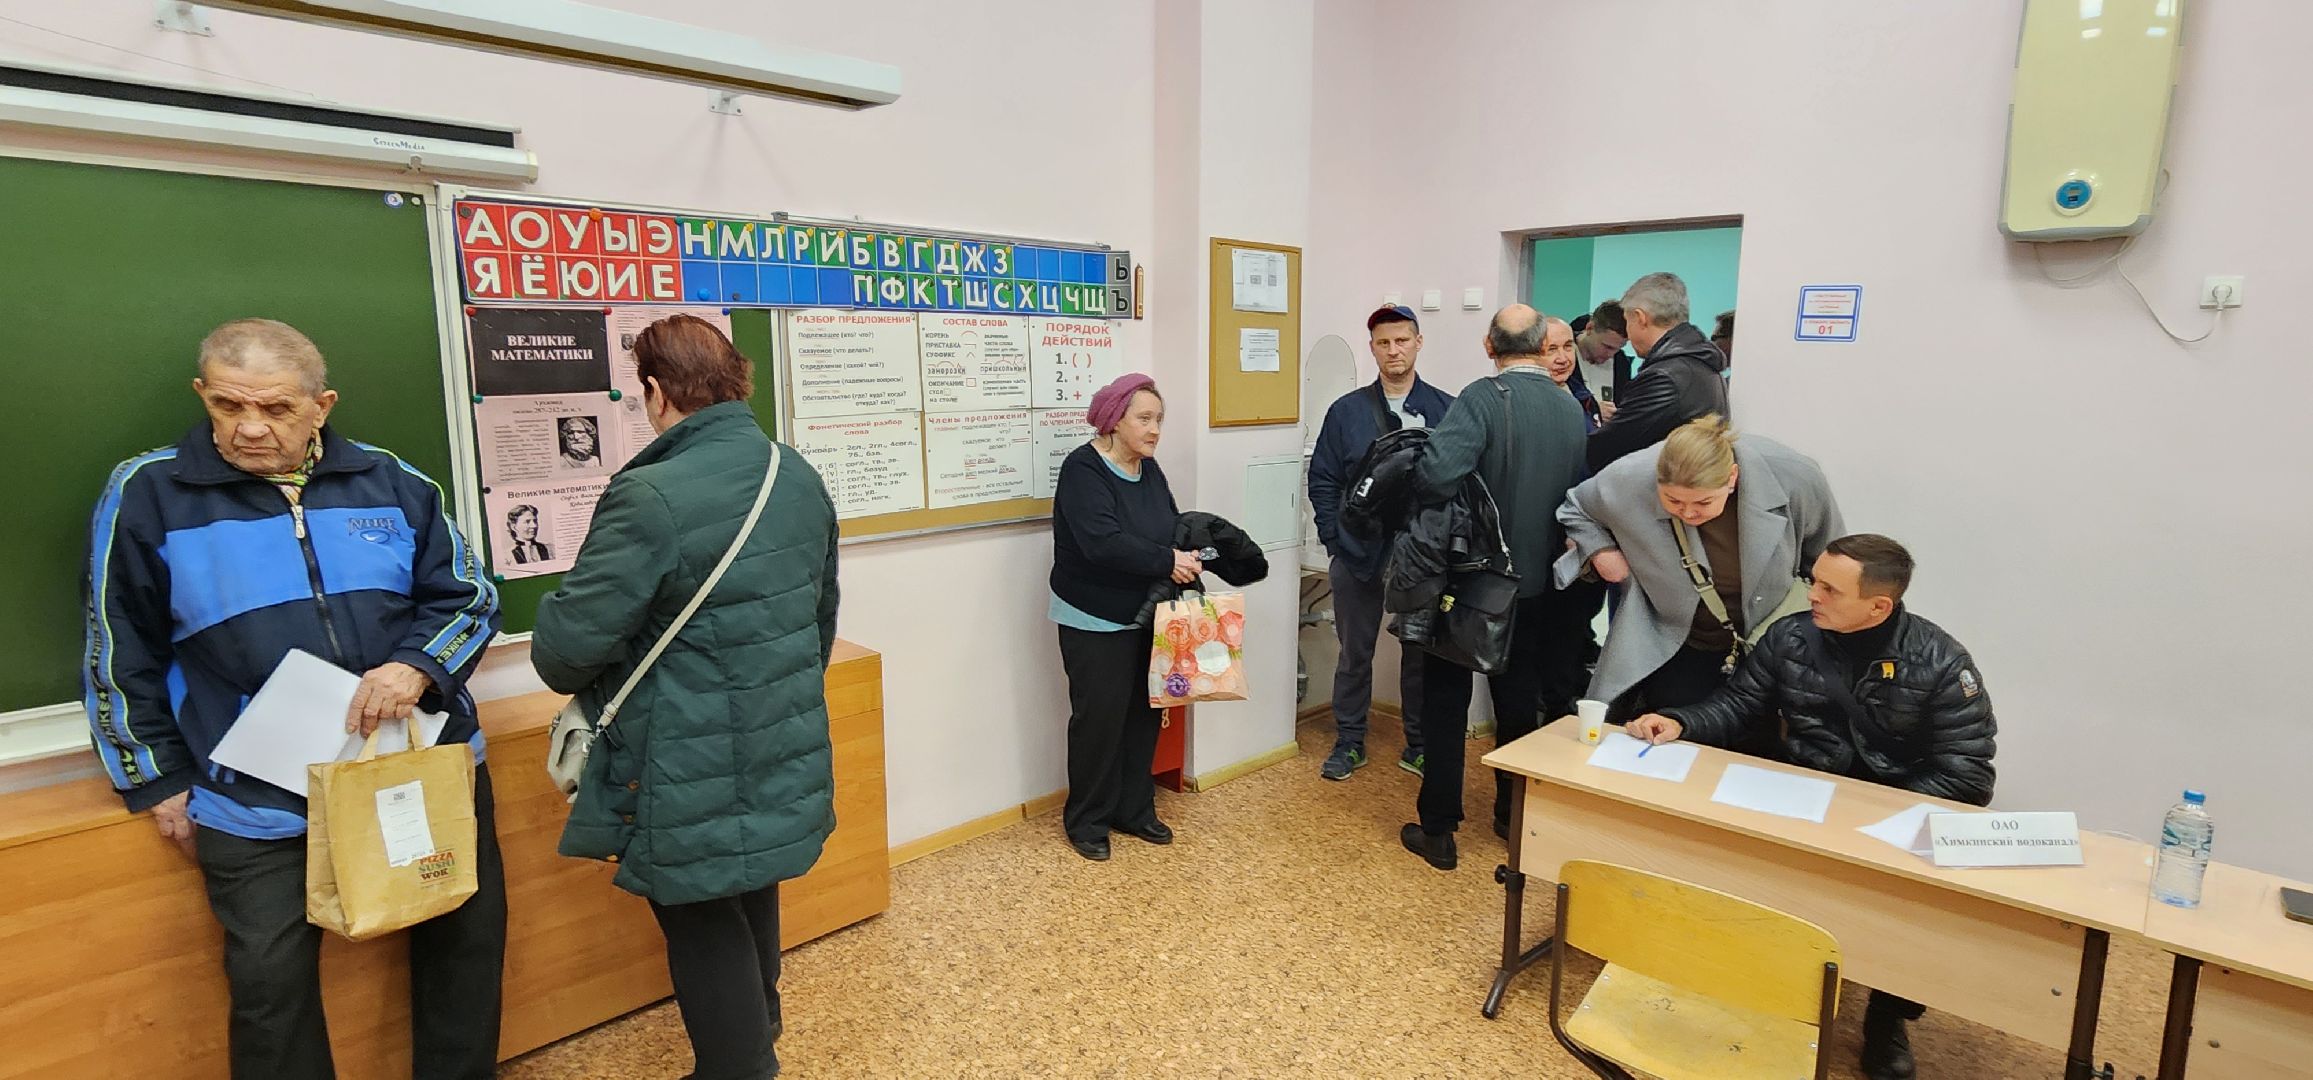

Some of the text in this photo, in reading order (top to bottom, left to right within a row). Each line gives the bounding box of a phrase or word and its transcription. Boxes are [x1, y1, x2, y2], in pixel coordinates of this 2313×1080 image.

[838, 316, 911, 324] ПРЕДЛОЖЕНИЯ
[943, 318, 977, 326] СОСТАВ
[1046, 323, 1109, 334] ПОРЯДОК
[1818, 325, 1833, 334] 01
[507, 335, 576, 347] ВЕЛИКИЕ
[1042, 334, 1112, 347] ДЕЙСТВИЙ
[491, 348, 593, 361] МАТЕМАТИКИ
[965, 412, 1027, 422] предложения
[808, 419, 902, 431] Фонетический разбор
[508, 489, 551, 499] Великие
[349, 517, 400, 536] NIKE
[441, 636, 463, 661] NIKE
[1991, 819, 2019, 831] ОАО
[420, 852, 454, 864] PIZZA
[419, 858, 455, 872] SUSHI
[421, 868, 448, 880] WOK
